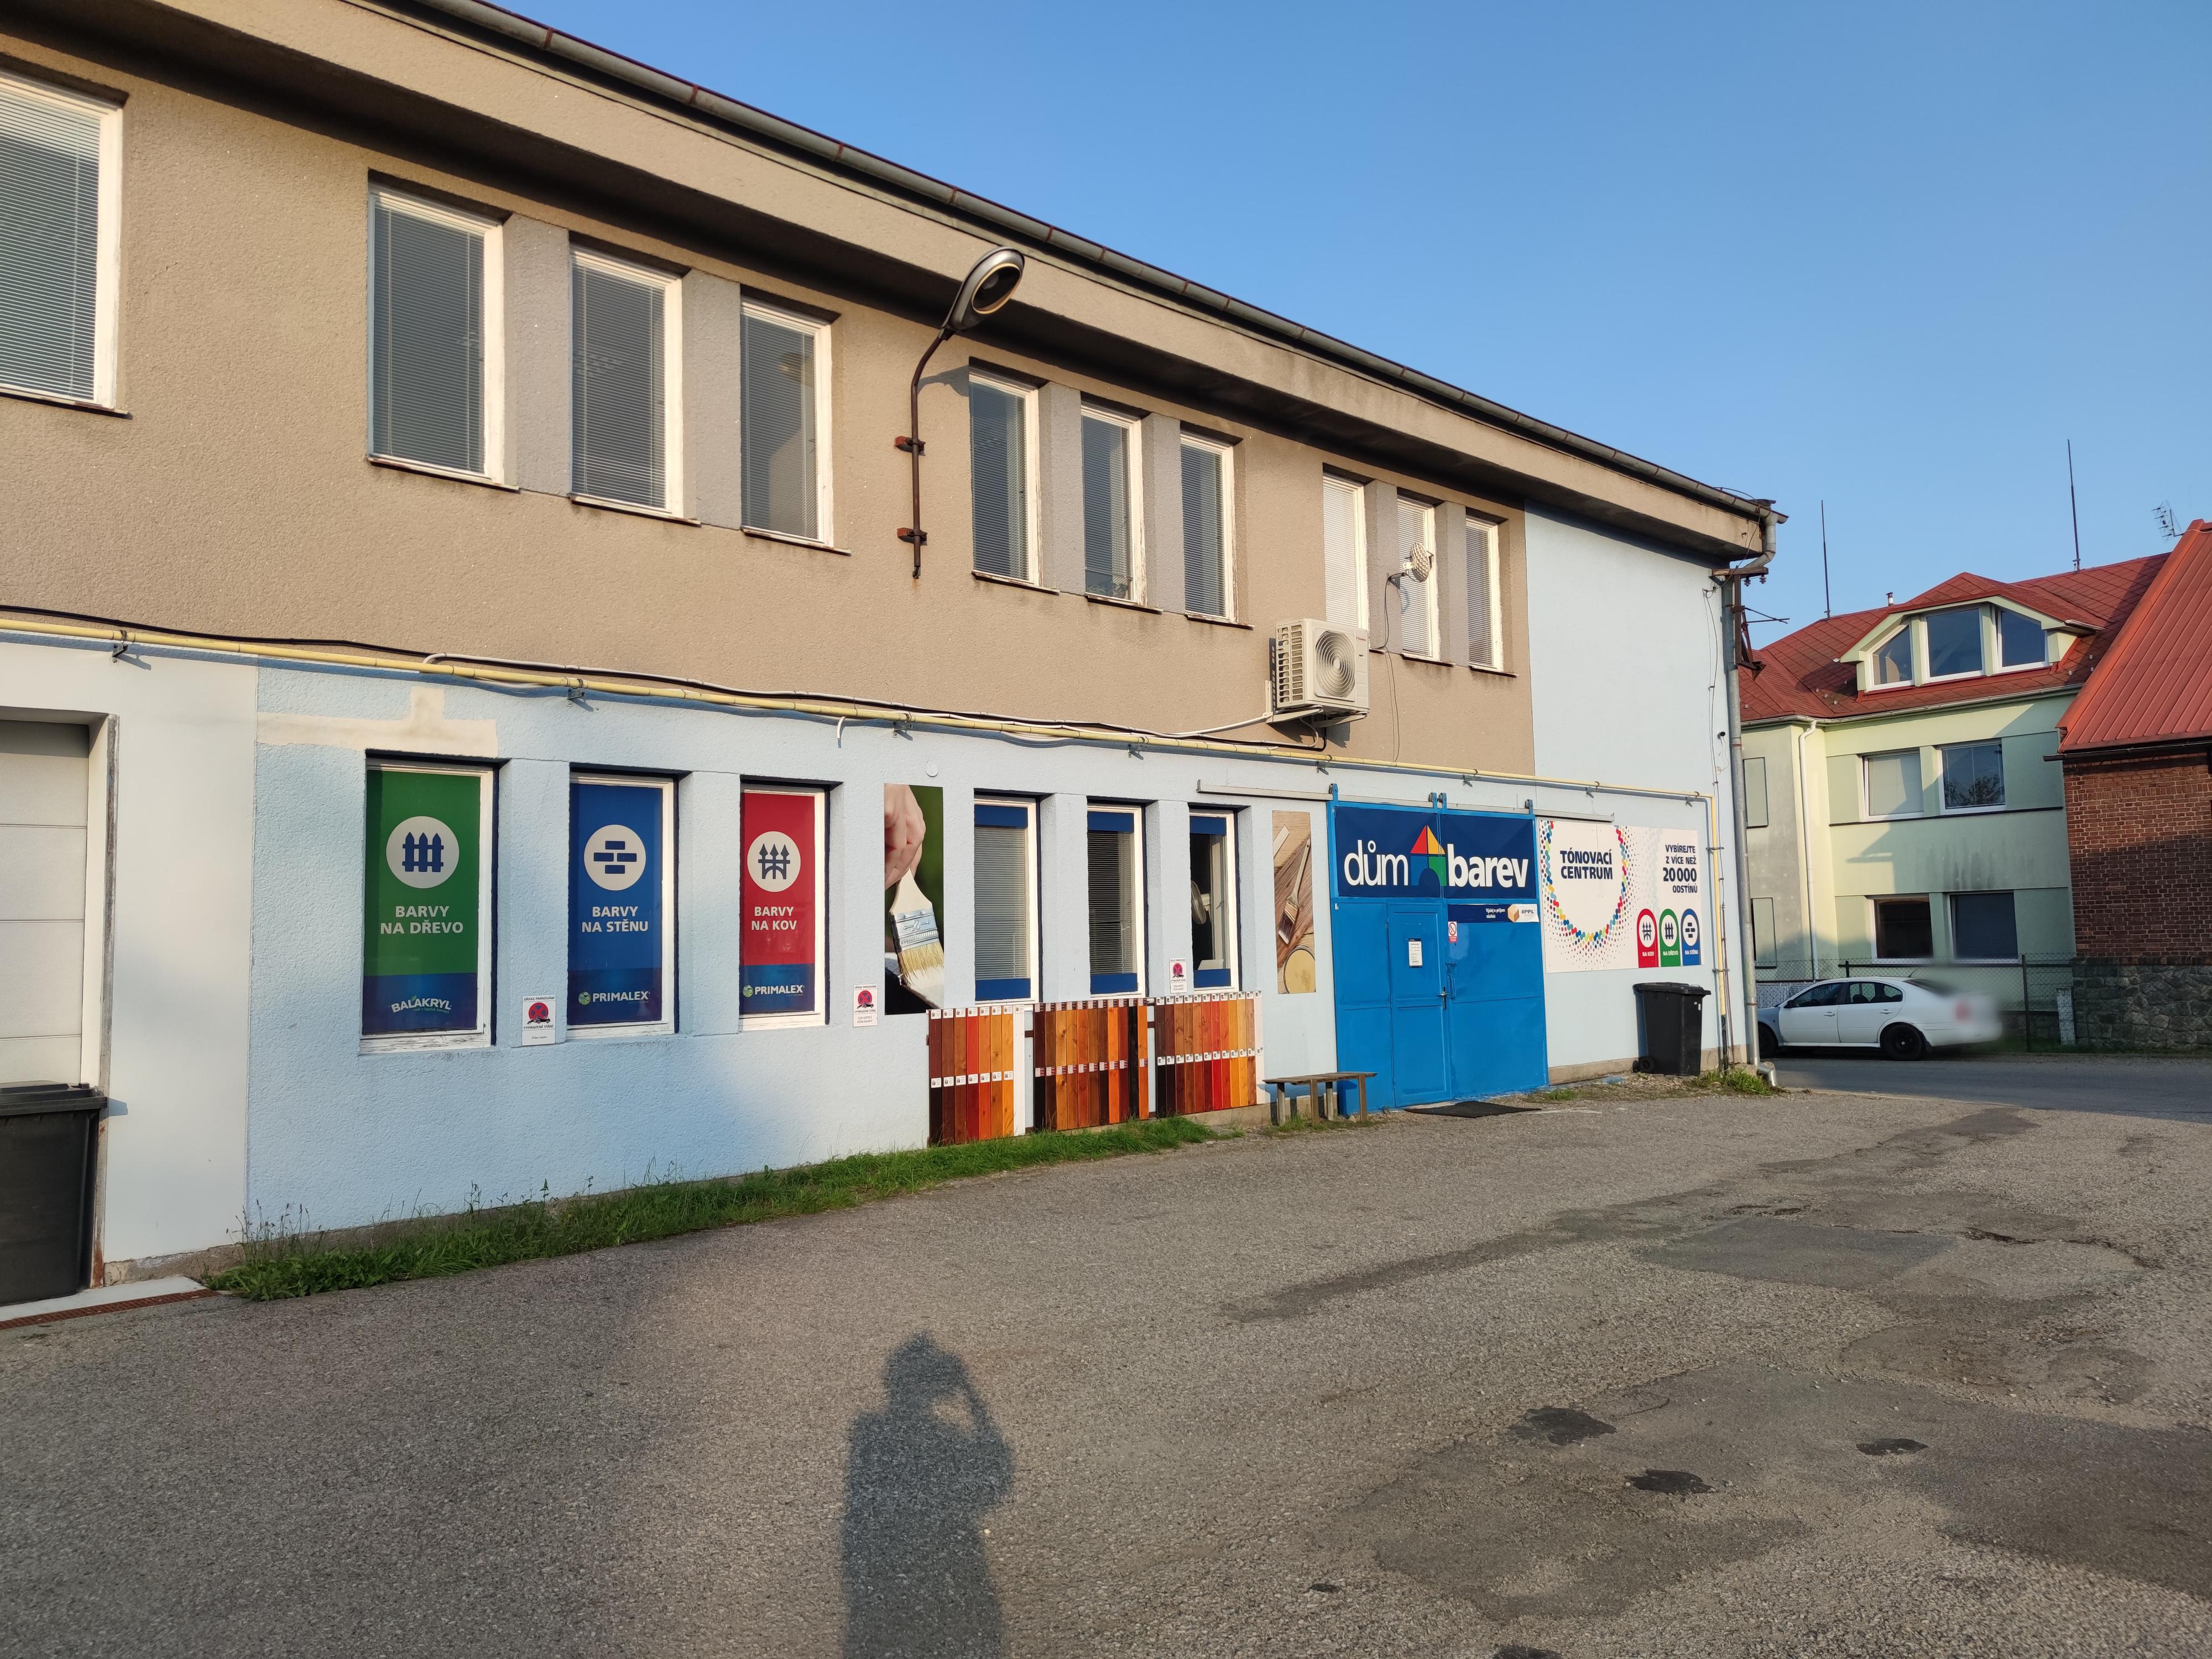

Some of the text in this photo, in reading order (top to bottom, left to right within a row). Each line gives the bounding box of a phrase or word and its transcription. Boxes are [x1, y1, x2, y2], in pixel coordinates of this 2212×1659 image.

[1665, 843, 1696, 853] VYBÍREJTE
[1560, 847, 1613, 865] TÓNOVACÍ
[1671, 854, 1684, 864] VÍCE
[1686, 855, 1697, 865] NEŽ
[1344, 839, 1528, 888] dům barev
[1561, 866, 1613, 880] CENTRUM
[1672, 883, 1698, 893] ODSTÍNŮ
[395, 905, 450, 917] BARVY
[592, 906, 638, 917] BARVY
[754, 906, 795, 916] BARVY
[380, 919, 463, 934] NA DŘEVO
[582, 919, 648, 932] NA STĚNU
[752, 920, 797, 930] NA KOV
[755, 984, 804, 995] PRIMALEX
[593, 990, 649, 1003] PRIMALEX
[391, 998, 452, 1013] BALAKRYL
